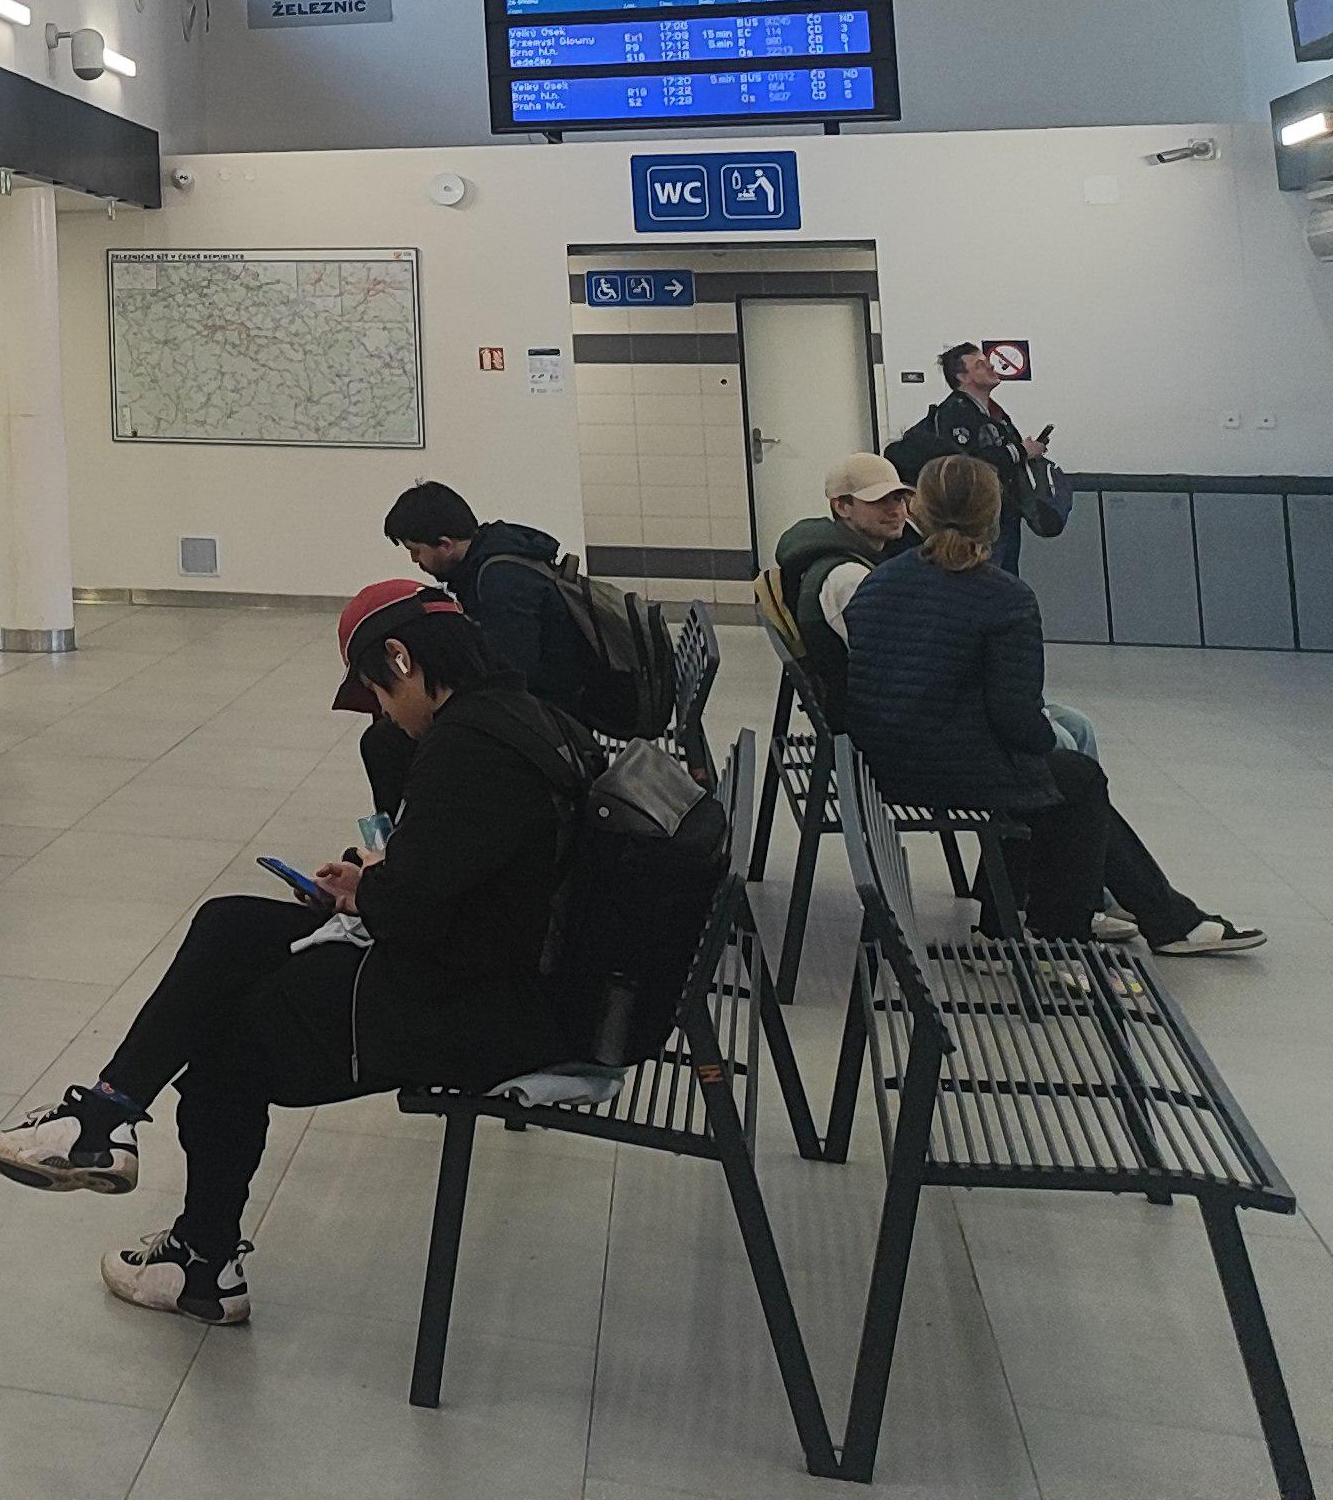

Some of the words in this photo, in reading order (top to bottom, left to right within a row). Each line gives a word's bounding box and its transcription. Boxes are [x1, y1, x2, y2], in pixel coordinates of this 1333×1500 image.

[271, 0, 366, 17] ŽELEZNIC
[736, 17, 759, 27] BUS
[737, 27, 752, 38] EC
[510, 48, 533, 57] Brno
[740, 72, 762, 83] BUS
[512, 93, 536, 102] Brno
[513, 101, 541, 111] Praha
[654, 181, 703, 206] WC
